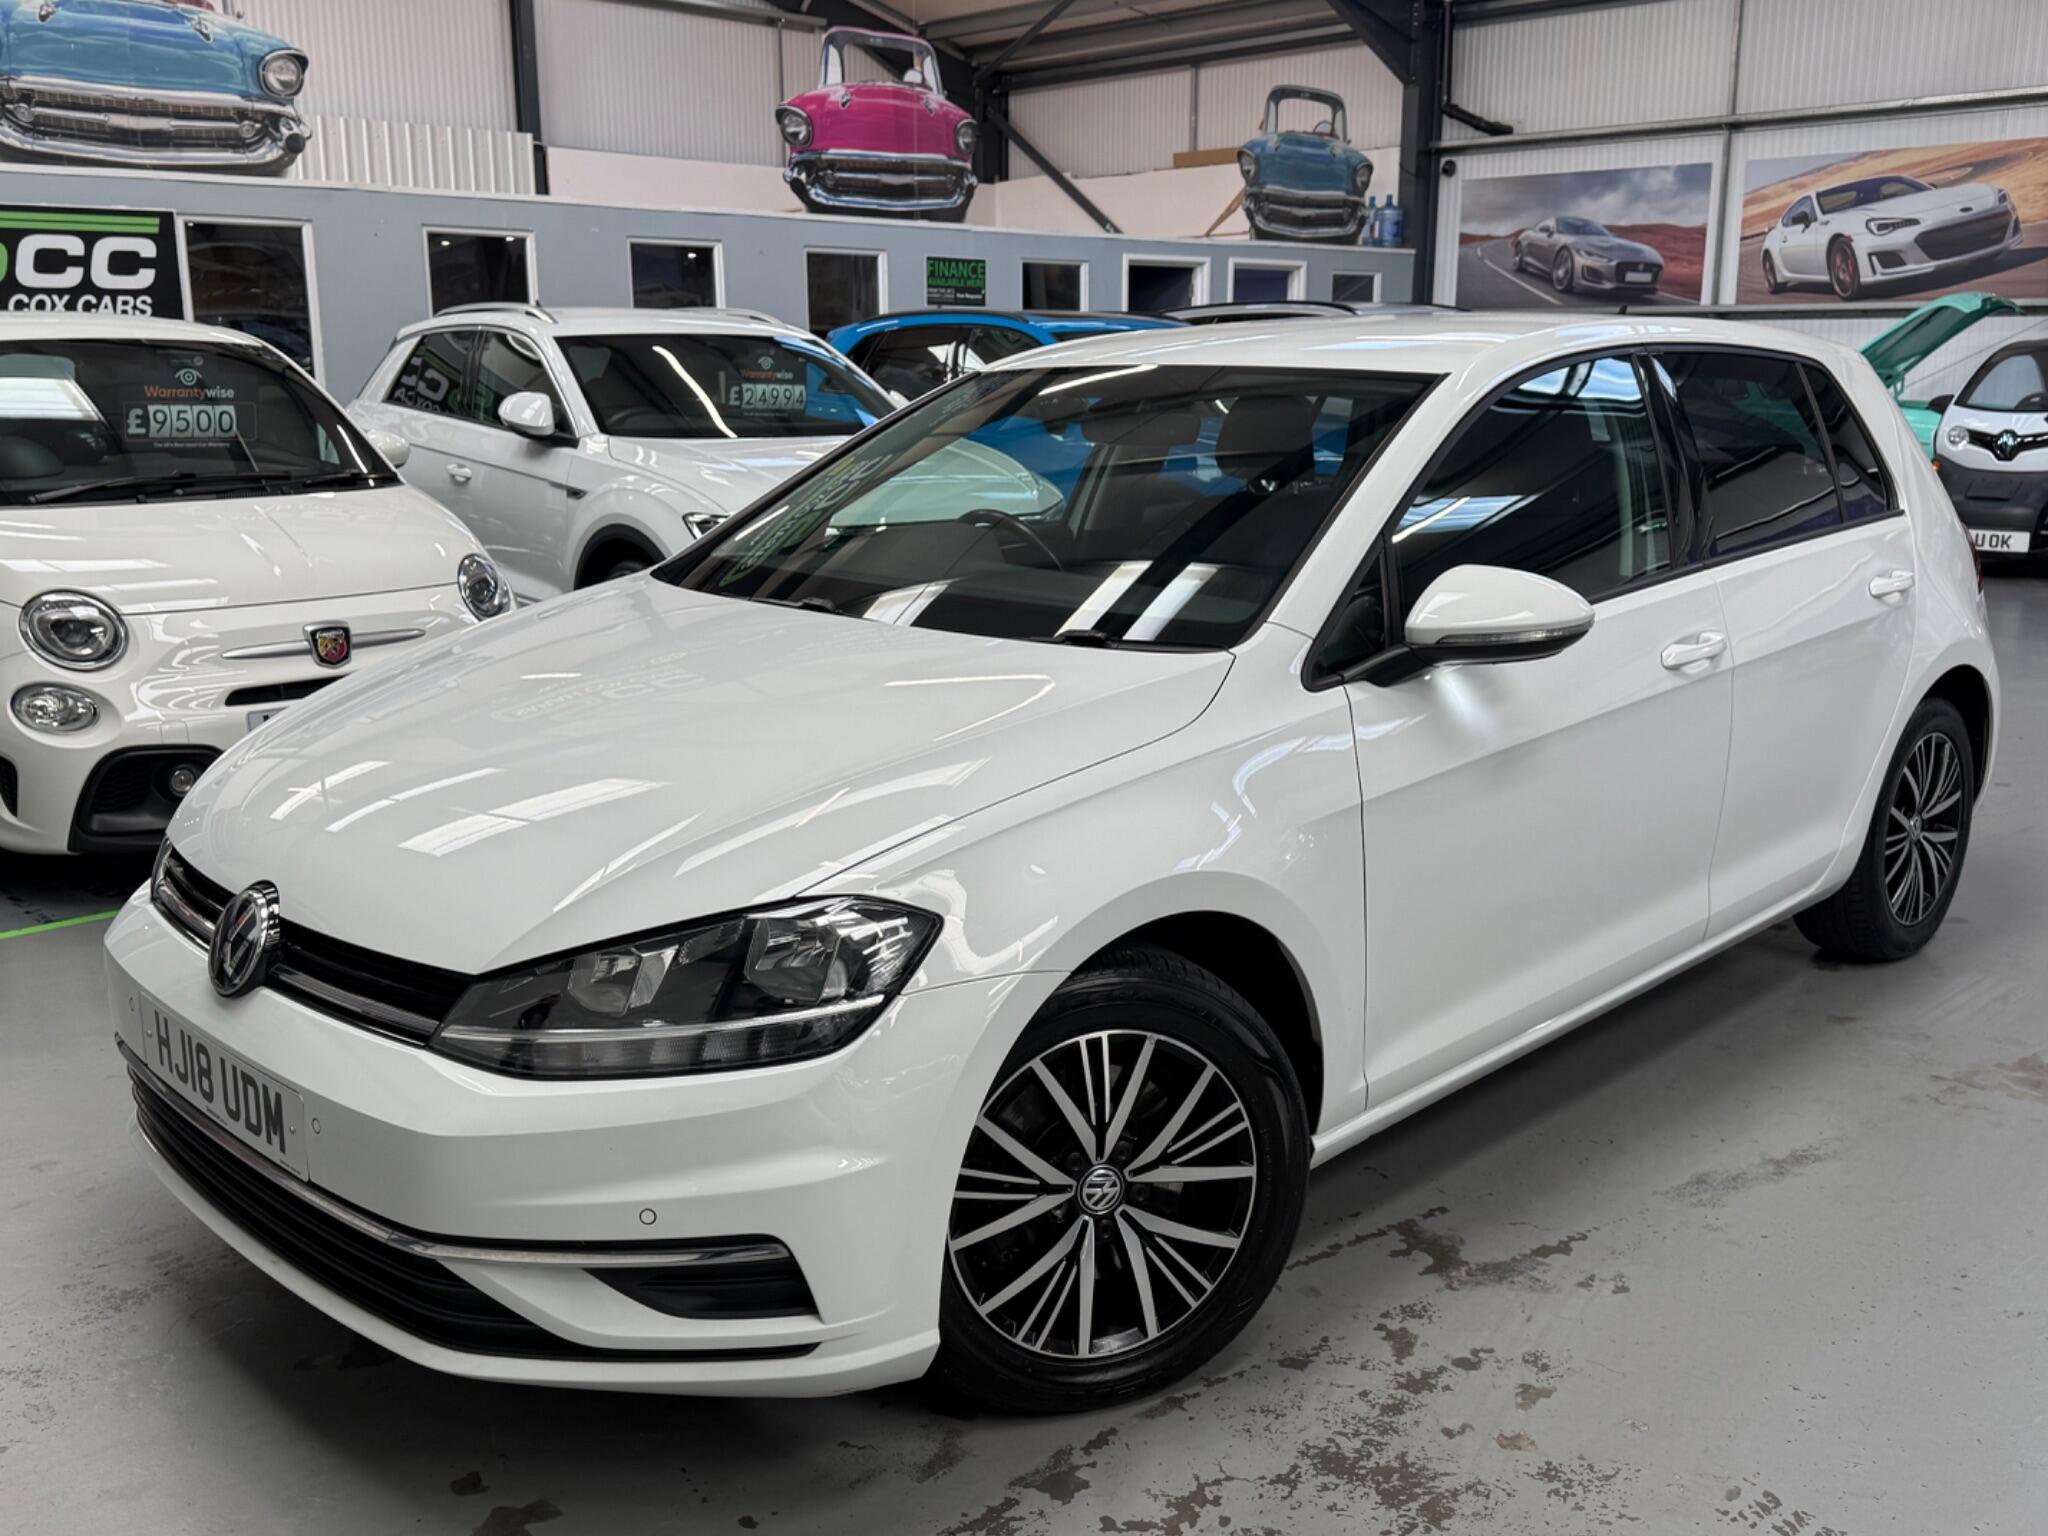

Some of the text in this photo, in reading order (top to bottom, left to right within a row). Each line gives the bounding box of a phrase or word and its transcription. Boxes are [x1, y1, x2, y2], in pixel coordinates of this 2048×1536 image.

[0, 234, 157, 290] CC
[927, 260, 985, 278] FINANCE
[8, 294, 153, 316] COX CARS
[144, 385, 235, 400] Warrantywise
[127, 408, 235, 435] £9500
[154, 1009, 286, 1155] HJ18 UDM
